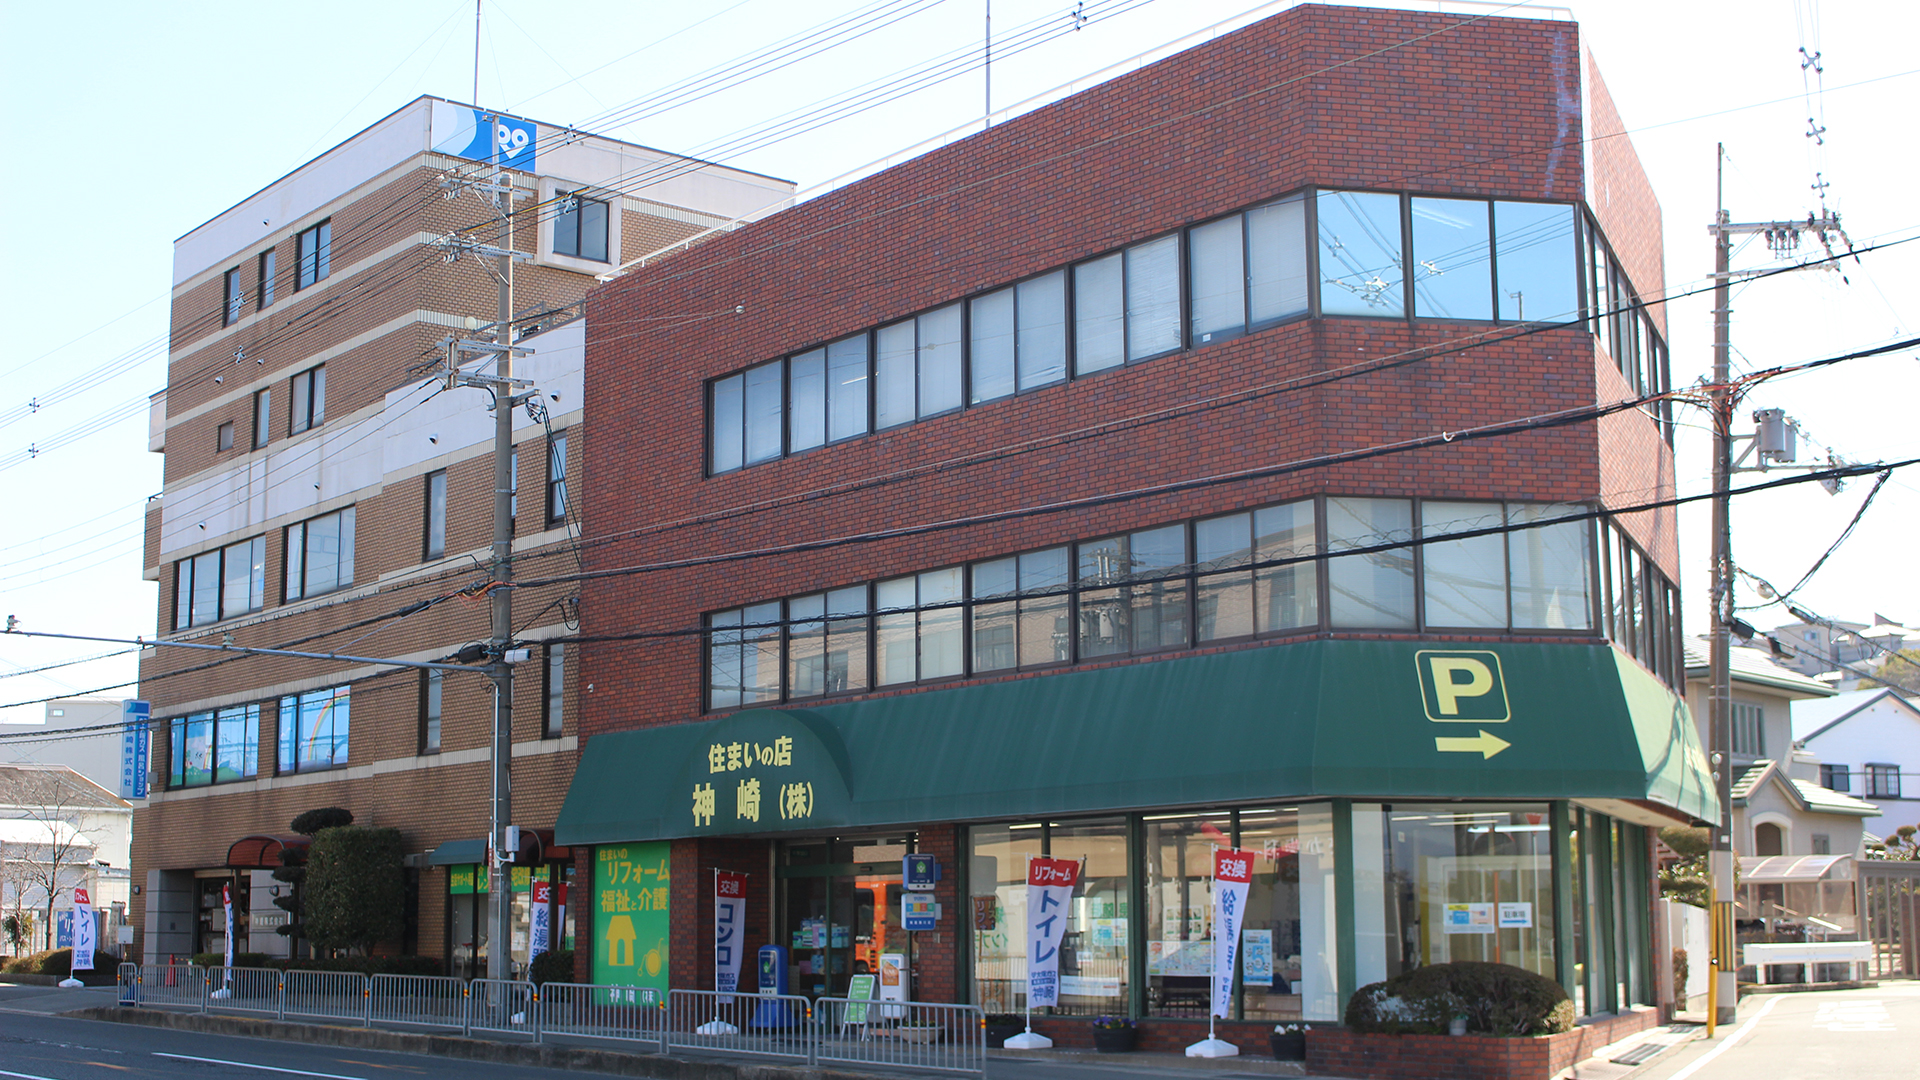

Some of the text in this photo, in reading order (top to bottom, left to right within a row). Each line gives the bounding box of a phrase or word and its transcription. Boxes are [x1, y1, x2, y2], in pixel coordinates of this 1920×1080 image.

[1429, 657, 1494, 716] P
[708, 736, 792, 774] 住まいの店
[599, 848, 628, 861] 住まいの
[1219, 858, 1248, 878] 交換
[608, 859, 671, 886] リフォーム
[1034, 865, 1071, 882] リフォーム
[601, 887, 668, 913] 福祉と介護
[720, 881, 739, 895] 交換
[79, 905, 90, 947] トイレ
[718, 903, 734, 966] コンロ
[1035, 889, 1060, 964] トイレ
